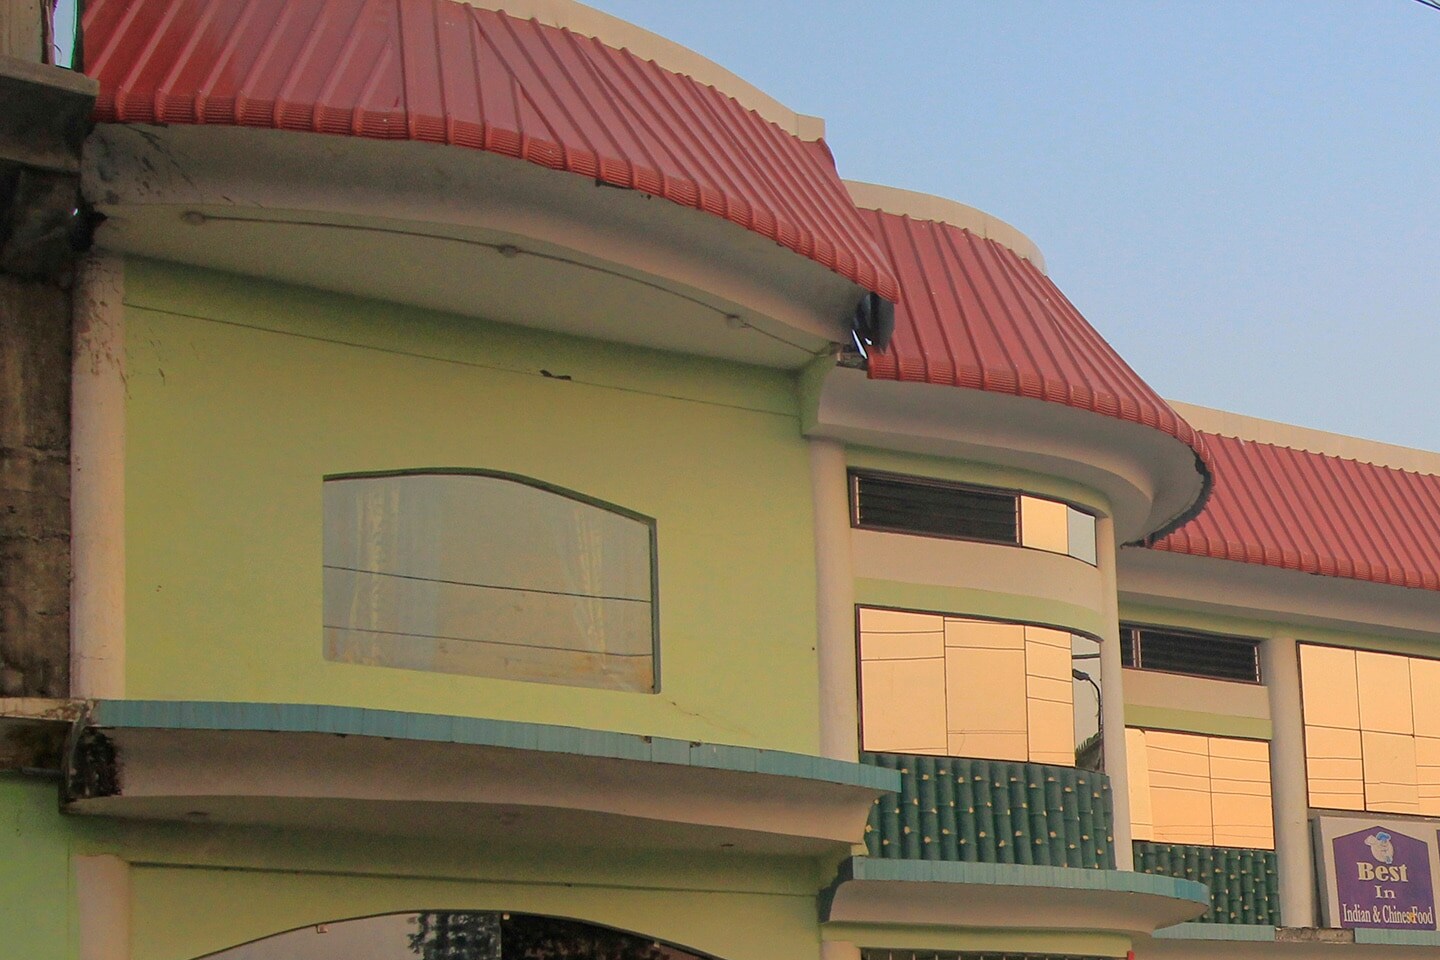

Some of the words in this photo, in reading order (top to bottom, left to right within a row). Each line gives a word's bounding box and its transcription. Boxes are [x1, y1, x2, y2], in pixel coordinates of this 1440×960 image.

[1357, 862, 1409, 882] Best
[1375, 885, 1396, 899] In
[1342, 903, 1371, 923] Indian
[1372, 905, 1381, 923] &
[1411, 906, 1434, 925] Food
